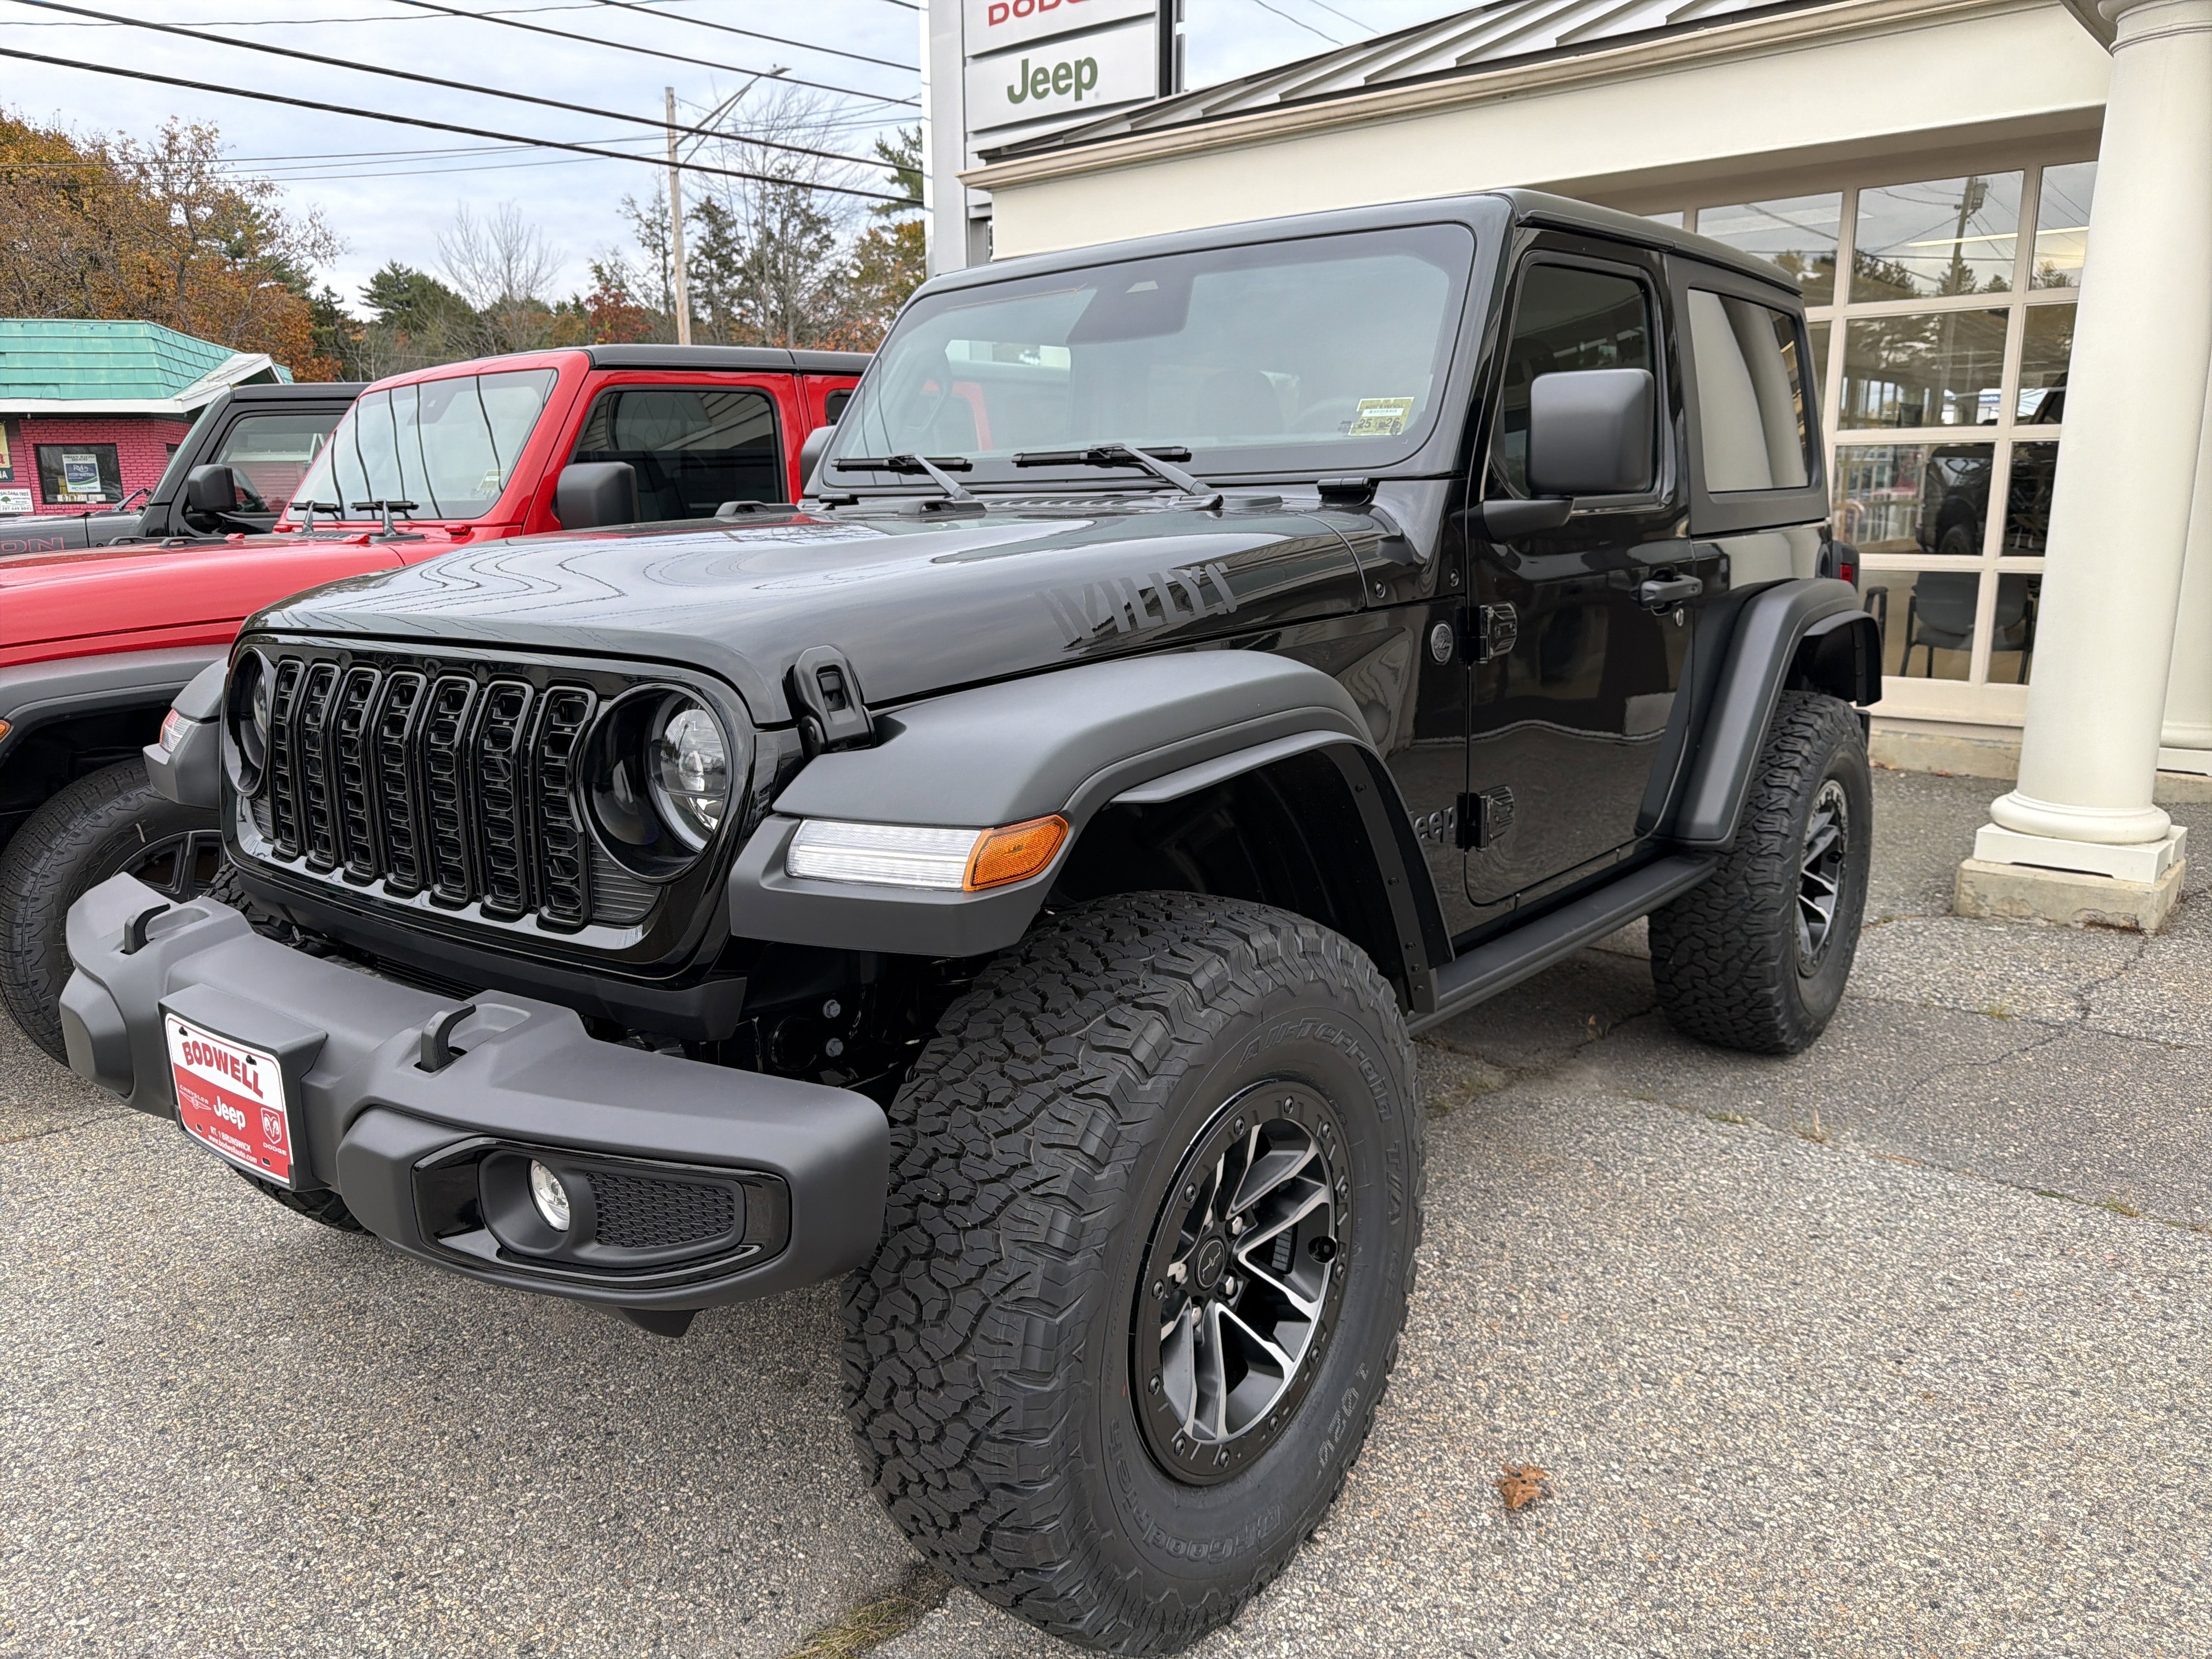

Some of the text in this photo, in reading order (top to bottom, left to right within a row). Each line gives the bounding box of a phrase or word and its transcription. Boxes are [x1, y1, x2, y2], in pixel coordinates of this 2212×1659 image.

[989, 0, 1091, 26] DOD
[1007, 57, 1098, 104] Jeep
[1358, 418, 1372, 429] 25
[1410, 806, 1457, 844] eep
[182, 1040, 263, 1099] BODWELL
[179, 1084, 209, 1105] CHRYSLER
[213, 1095, 246, 1130] Jeep
[208, 1135, 257, 1164] www.bodwellauto.com
[222, 1132, 252, 1153] BRUNSWICK
[263, 1142, 287, 1156] DODGE
